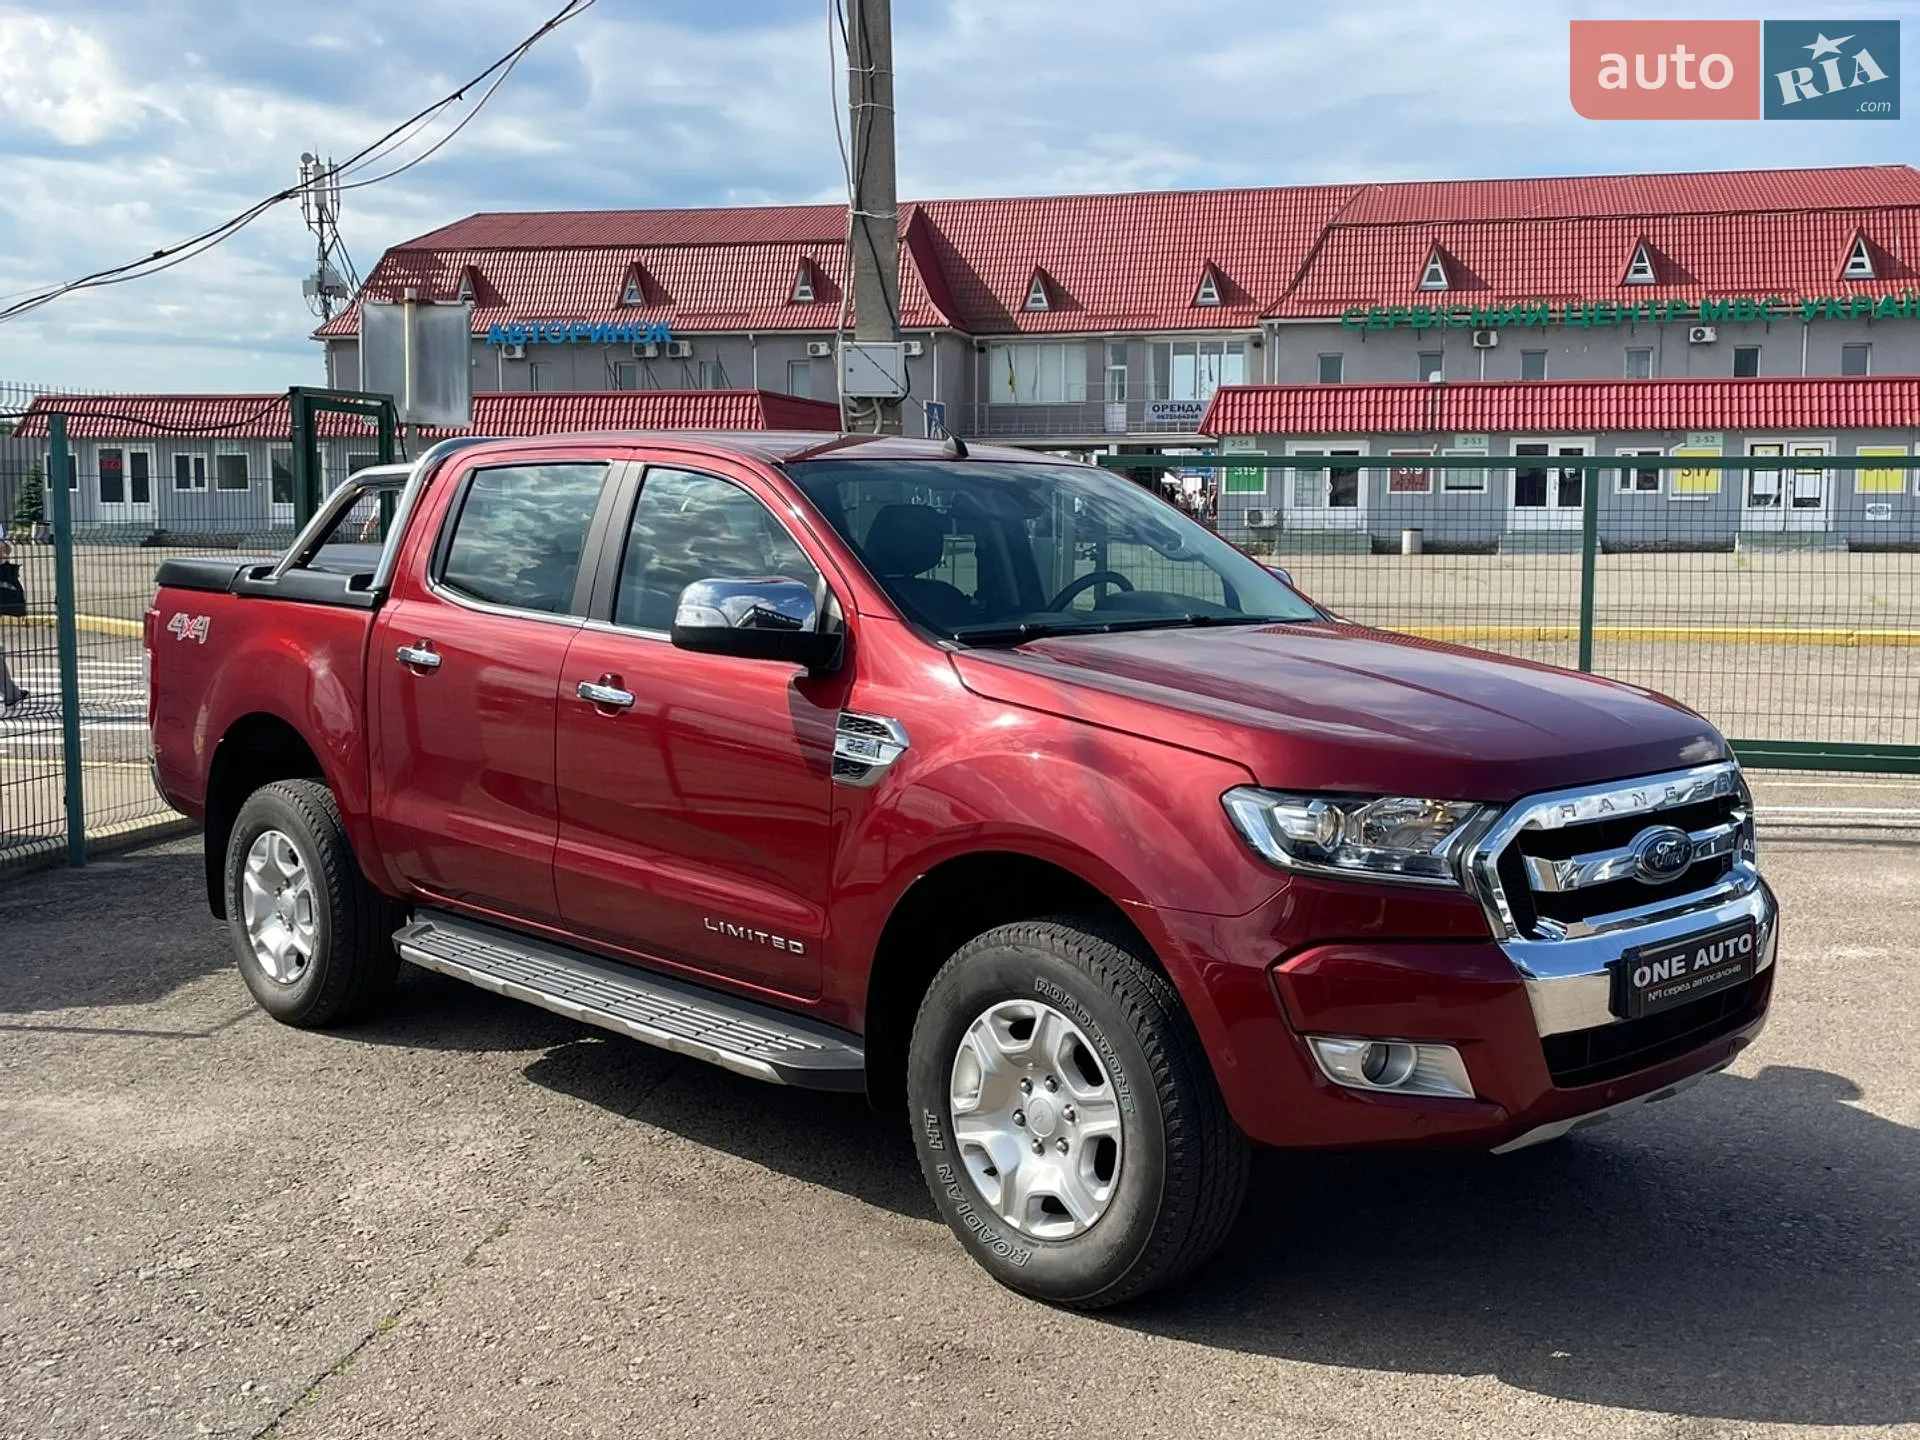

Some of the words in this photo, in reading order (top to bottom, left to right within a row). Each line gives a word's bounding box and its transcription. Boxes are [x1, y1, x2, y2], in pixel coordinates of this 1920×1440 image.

[1340, 298, 1549, 330] СЕРВІСНИЙ
[1565, 299, 1689, 329] ЦЕНТР
[1700, 296, 1784, 321] МВС
[1799, 288, 1920, 321] УКРАЇ
[487, 321, 673, 345] АВТОРИНОК
[1151, 403, 1203, 413] ОРЕНДА
[1560, 775, 1734, 819] RANGER
[1652, 840, 1687, 869] Ford
[703, 917, 805, 955] LIMITED
[1633, 954, 1686, 988] ONE
[1693, 933, 1752, 970] AUTO
[924, 1109, 945, 1151] HT
[936, 1163, 1032, 1268] ROADIAN
